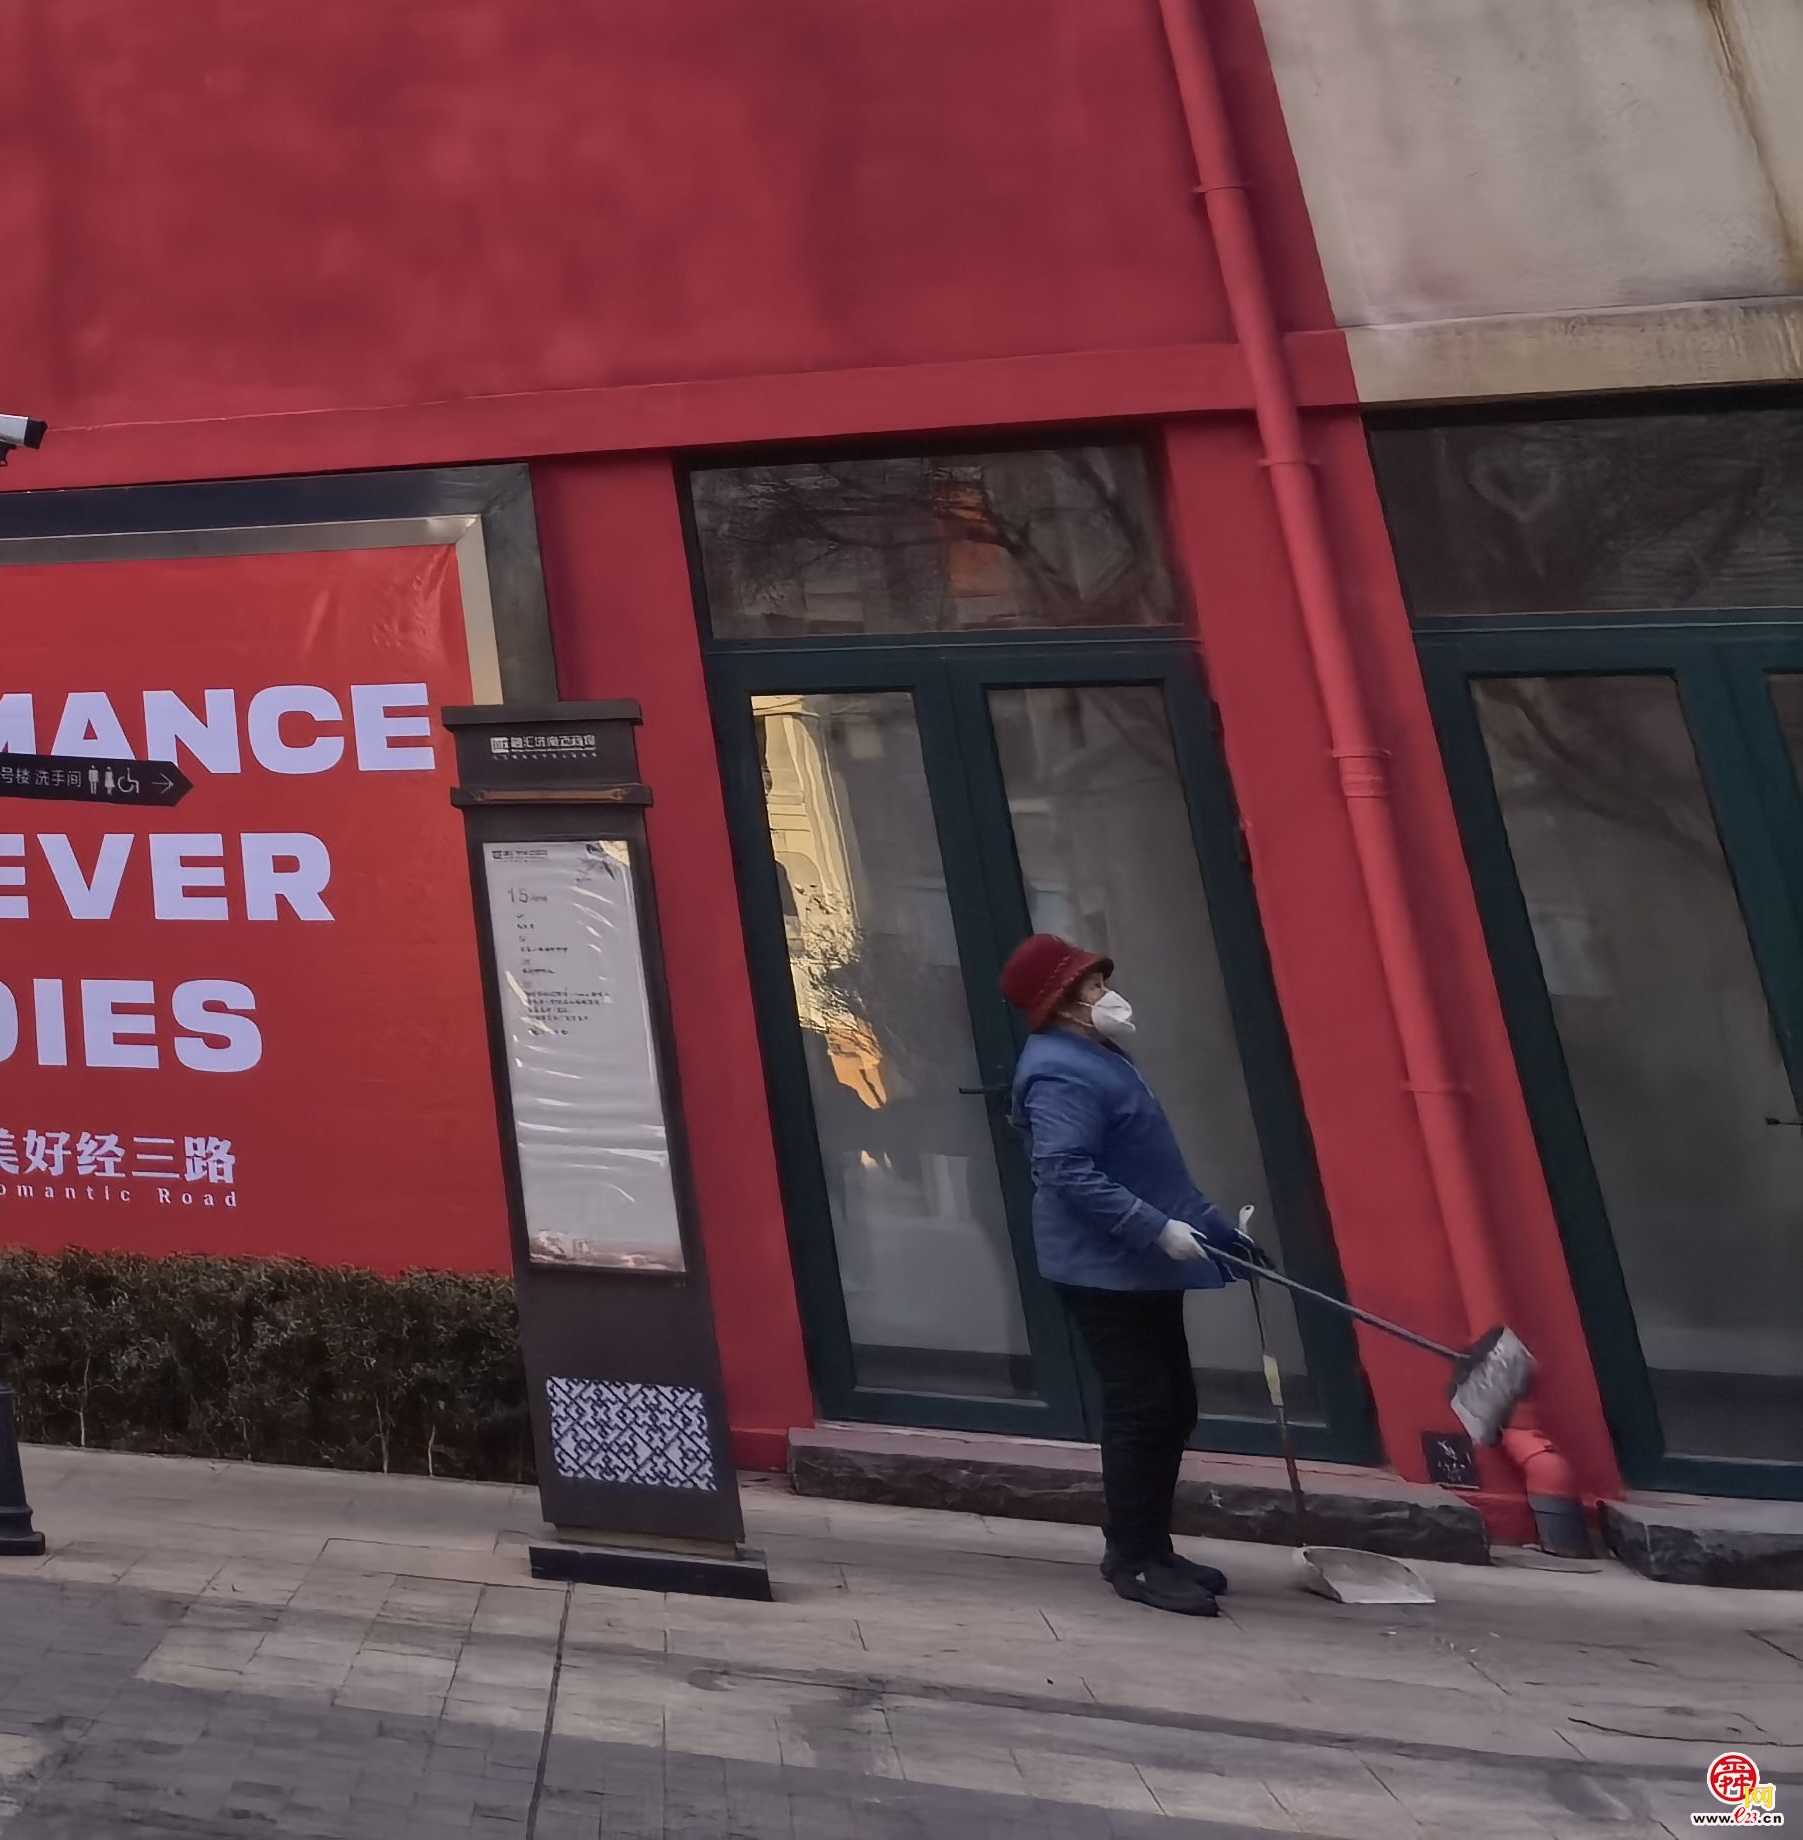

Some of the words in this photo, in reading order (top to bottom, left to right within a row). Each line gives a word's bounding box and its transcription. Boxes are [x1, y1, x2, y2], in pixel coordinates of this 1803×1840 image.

[35, 769, 83, 788] 洗手间
[157, 1187, 237, 1208] Road
